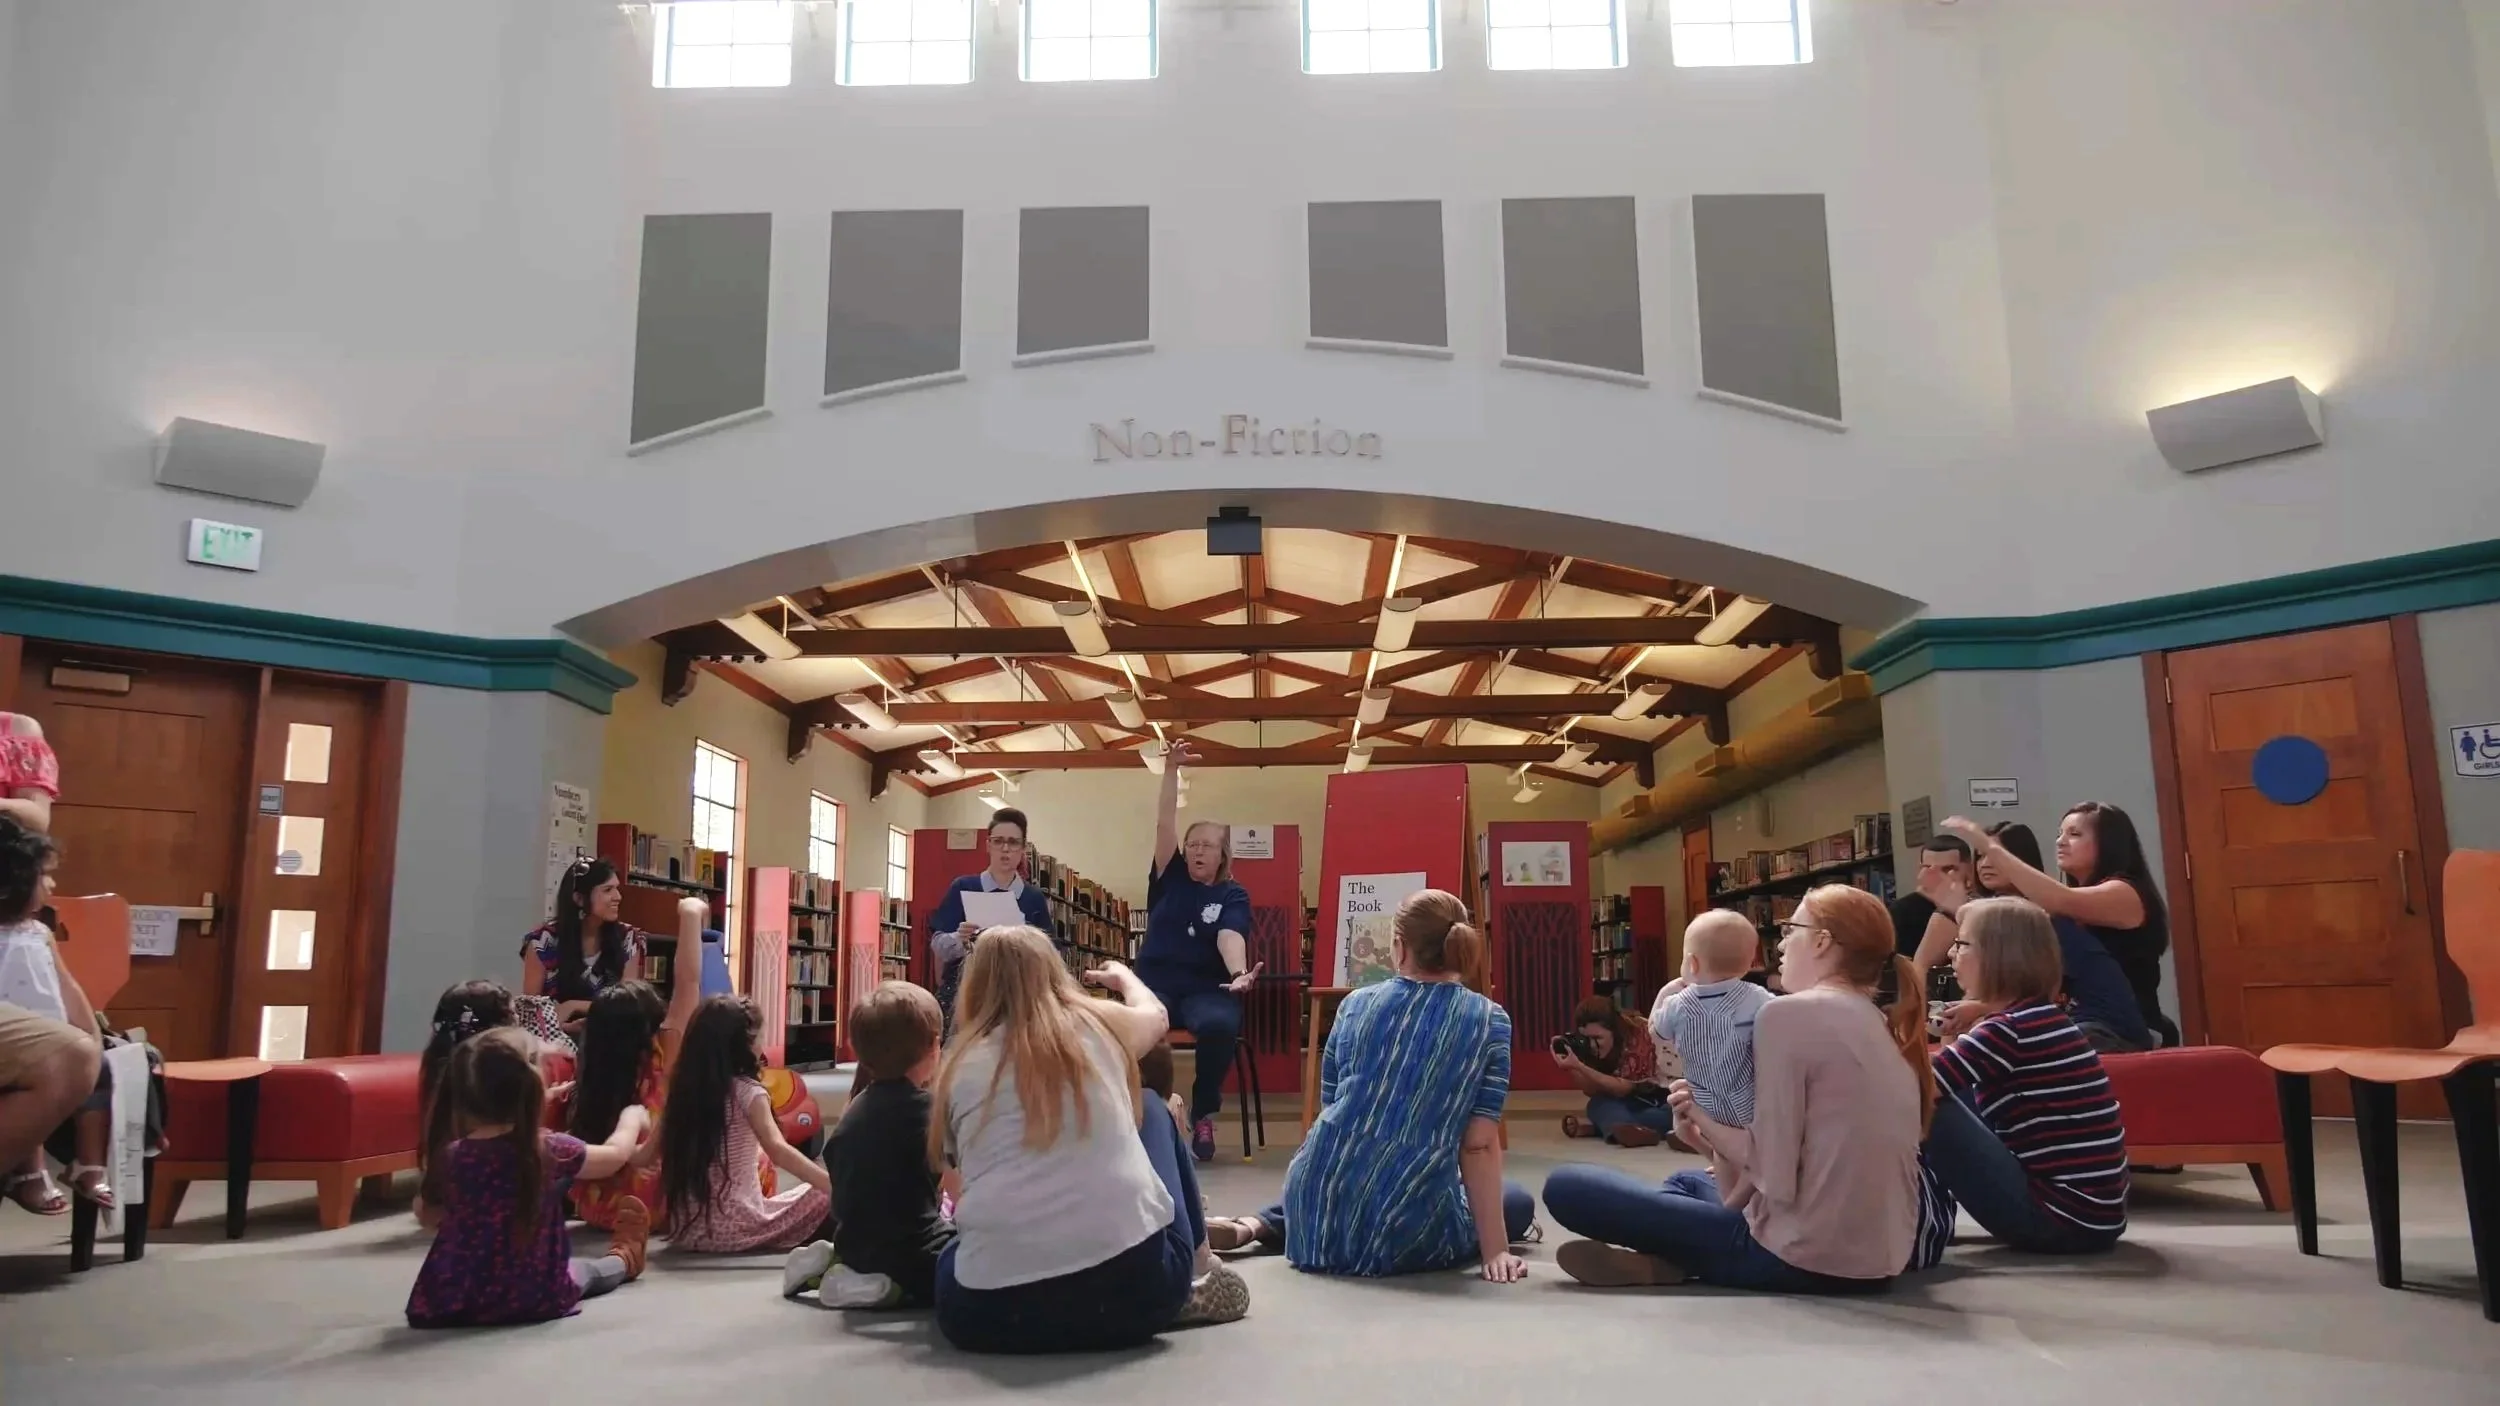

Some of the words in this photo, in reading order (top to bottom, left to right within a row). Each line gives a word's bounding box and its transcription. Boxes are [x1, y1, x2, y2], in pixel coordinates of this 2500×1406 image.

[1090, 414, 1382, 463] Non-Fiction
[1348, 882, 1375, 895] The
[1348, 899, 1383, 912] Book
